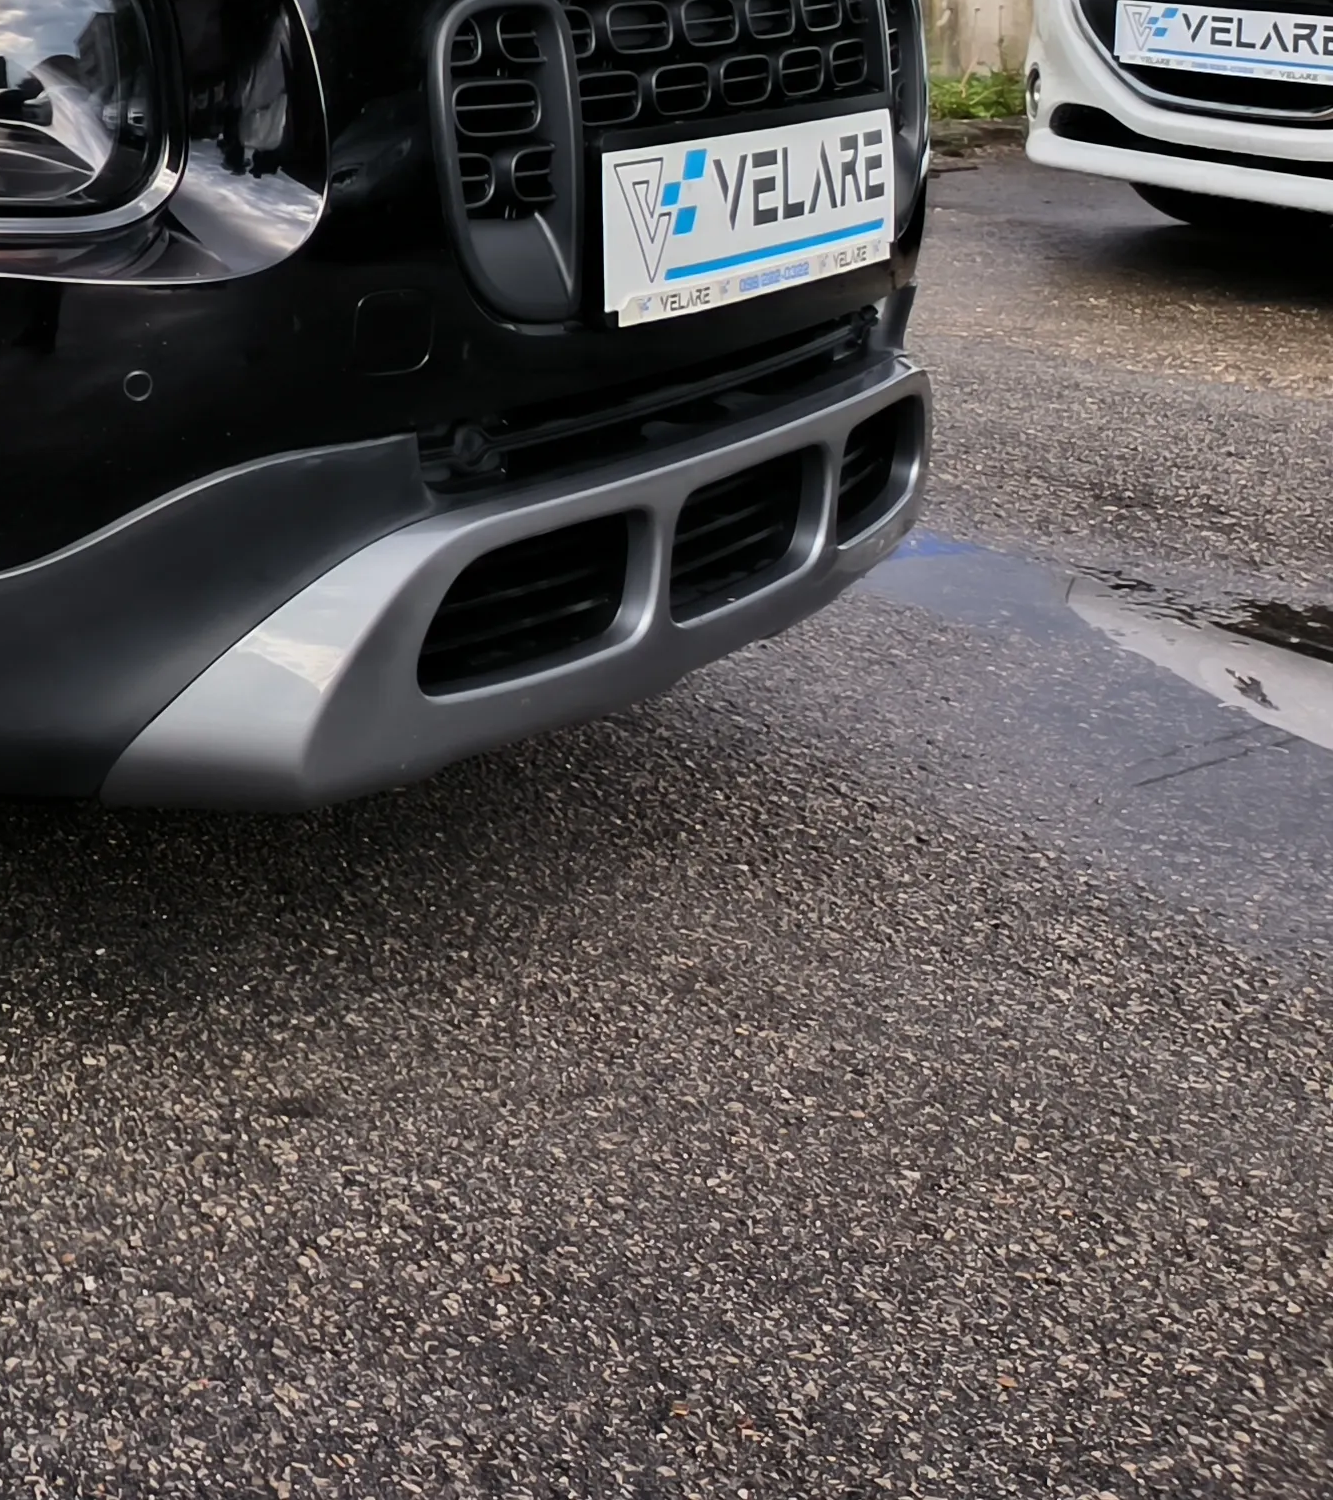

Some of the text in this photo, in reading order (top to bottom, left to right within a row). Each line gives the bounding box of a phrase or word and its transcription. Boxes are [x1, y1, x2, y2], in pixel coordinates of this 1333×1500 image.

[712, 129, 885, 231] VELARE
[833, 245, 868, 269] VELARE
[660, 286, 711, 312] VELARE
